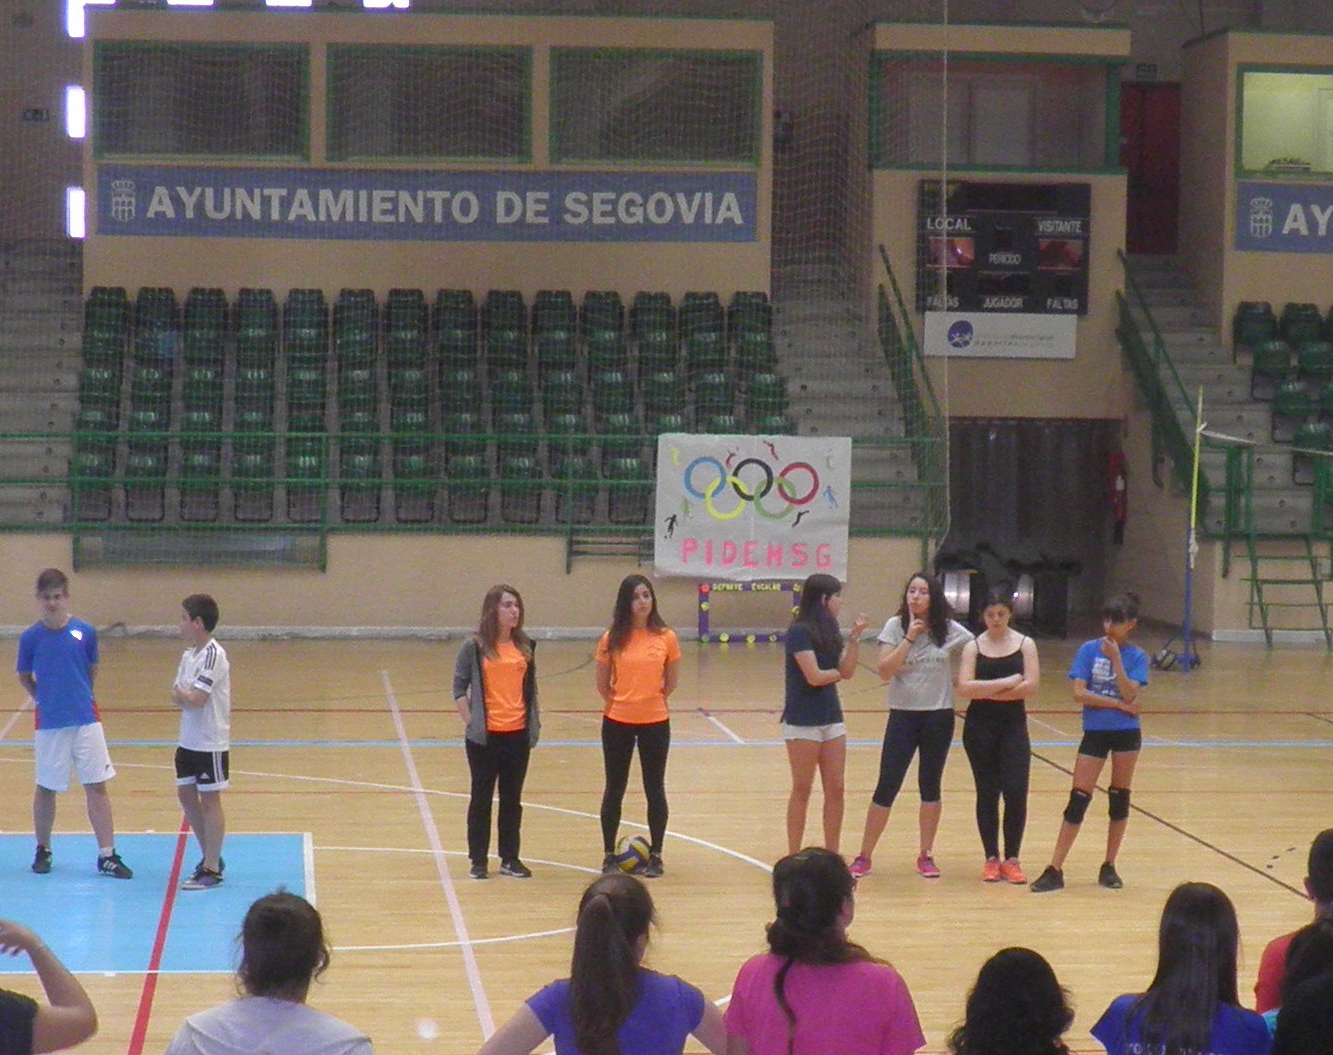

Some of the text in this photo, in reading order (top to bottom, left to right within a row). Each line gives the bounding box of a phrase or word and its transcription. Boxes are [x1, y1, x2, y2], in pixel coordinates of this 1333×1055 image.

[146, 186, 744, 226] AYUNTAMIENTO DE SEGOVIA
[926, 217, 972, 231] LOCAL
[1037, 220, 1083, 233] VISITANTE
[982, 298, 1024, 309] JUGADOR
[1046, 298, 1079, 310] FALTAS
